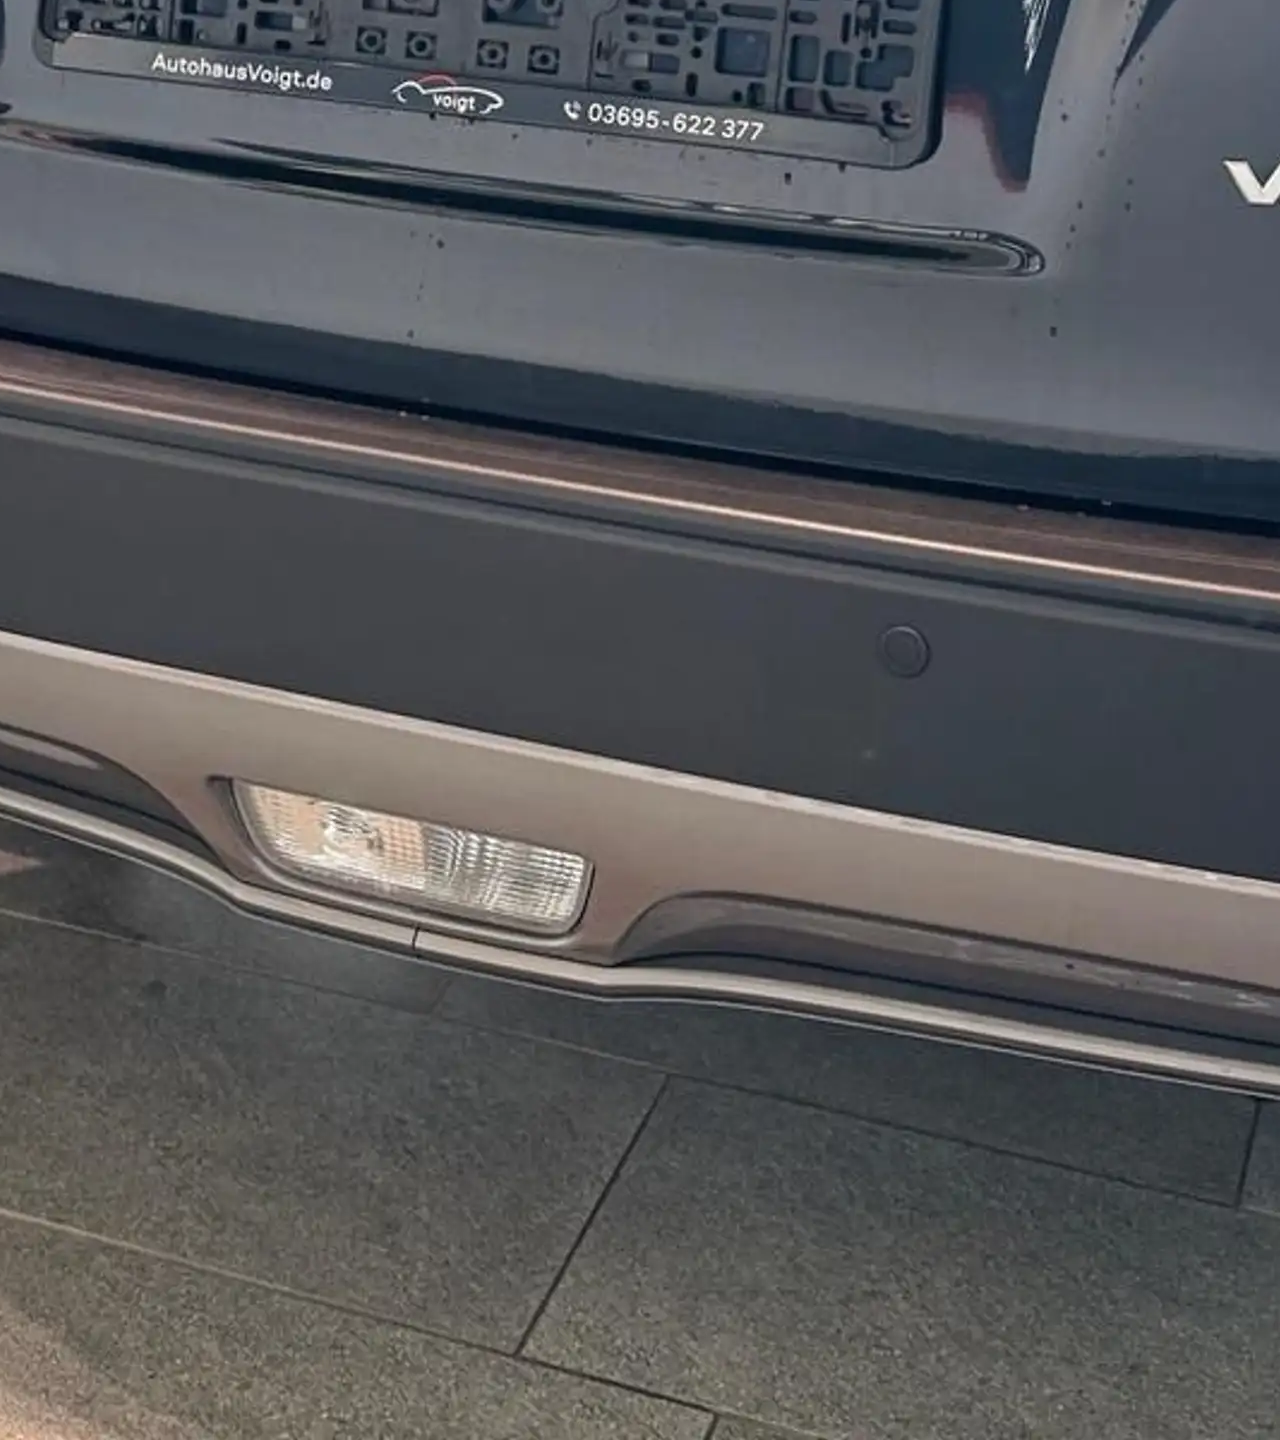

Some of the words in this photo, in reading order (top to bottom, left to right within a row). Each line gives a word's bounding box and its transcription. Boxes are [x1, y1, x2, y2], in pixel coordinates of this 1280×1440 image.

[151, 51, 333, 92] AutohausVoigt.de
[433, 92, 476, 113] voigt
[587, 102, 716, 136] 03695-622
[721, 117, 764, 142] 377
